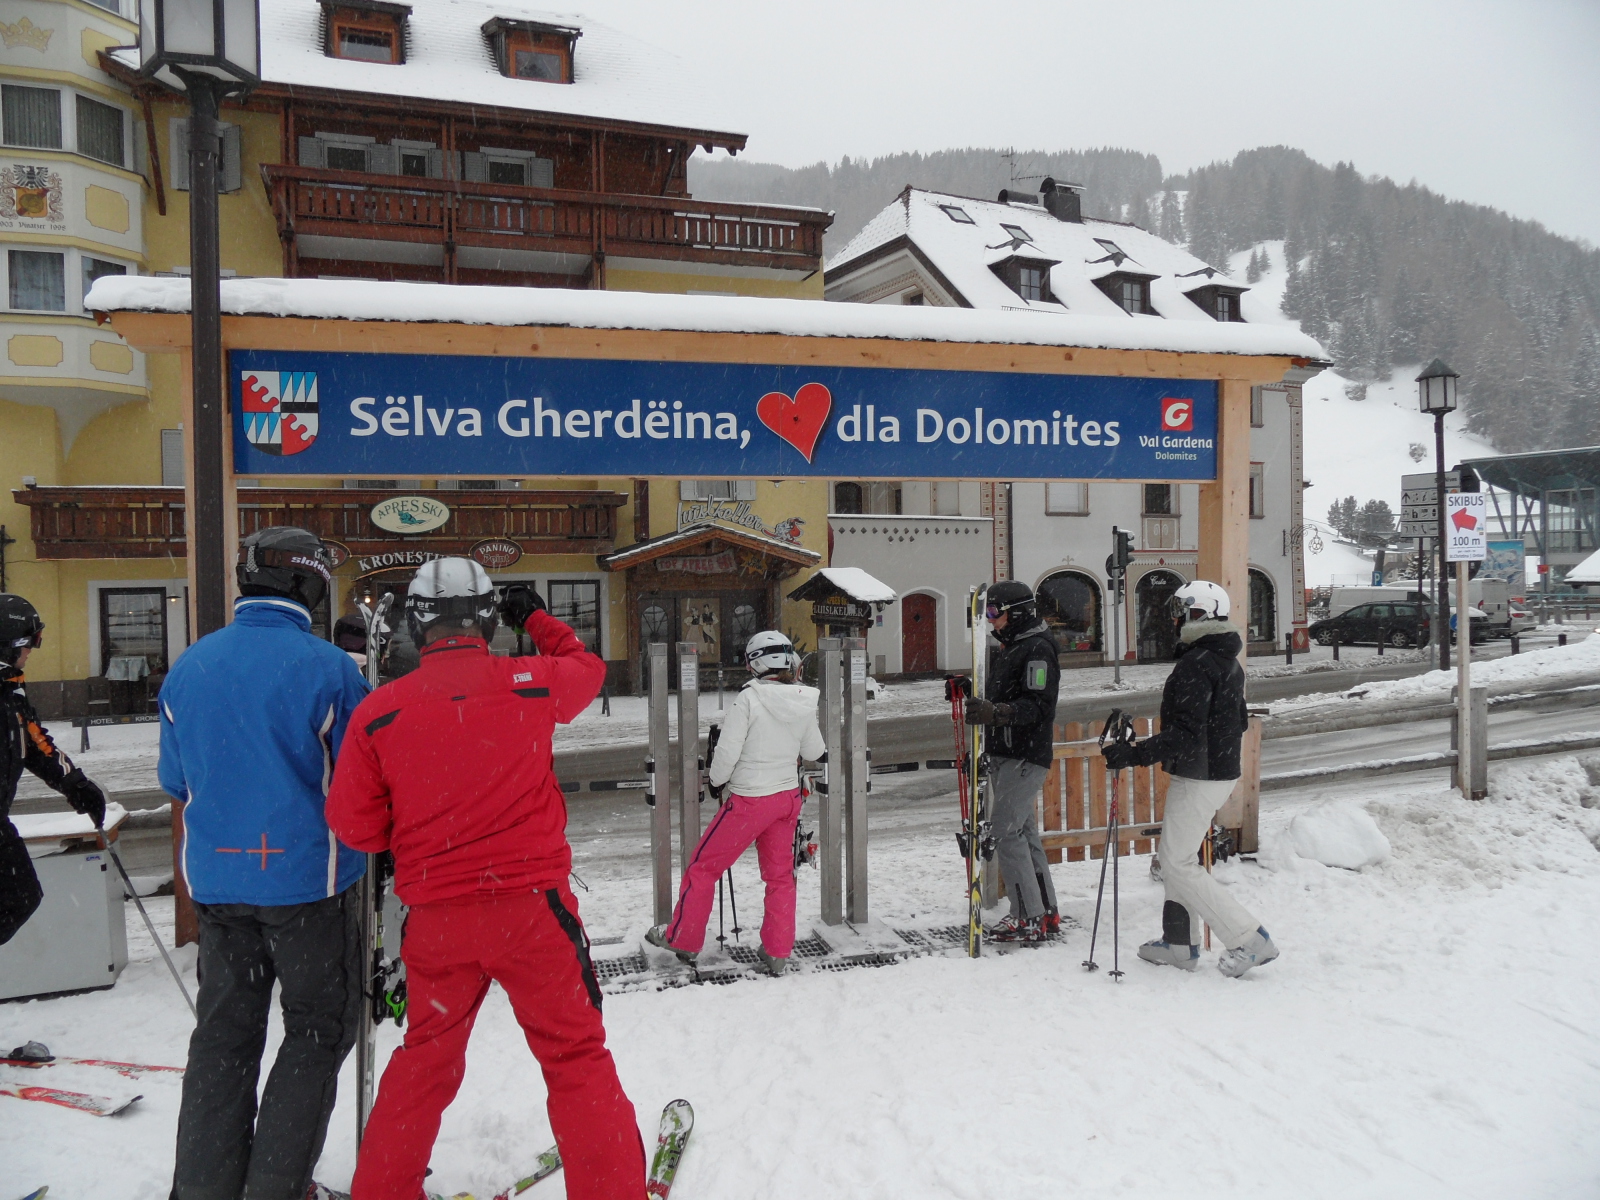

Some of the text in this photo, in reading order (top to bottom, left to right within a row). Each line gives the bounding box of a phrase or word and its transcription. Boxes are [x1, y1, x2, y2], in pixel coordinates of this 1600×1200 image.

[350, 395, 1121, 449] Sëlva Gherdëina, dla Dolomites
[1139, 435, 1213, 449] Val Gardena
[1155, 451, 1197, 461] Dolomites
[1448, 495, 1484, 507] SKIBUS
[378, 499, 443, 519] APRES SKI
[1453, 536, 1481, 546] 100 m
[479, 544, 515, 555] PANINO
[484, 554, 510, 563] Point
